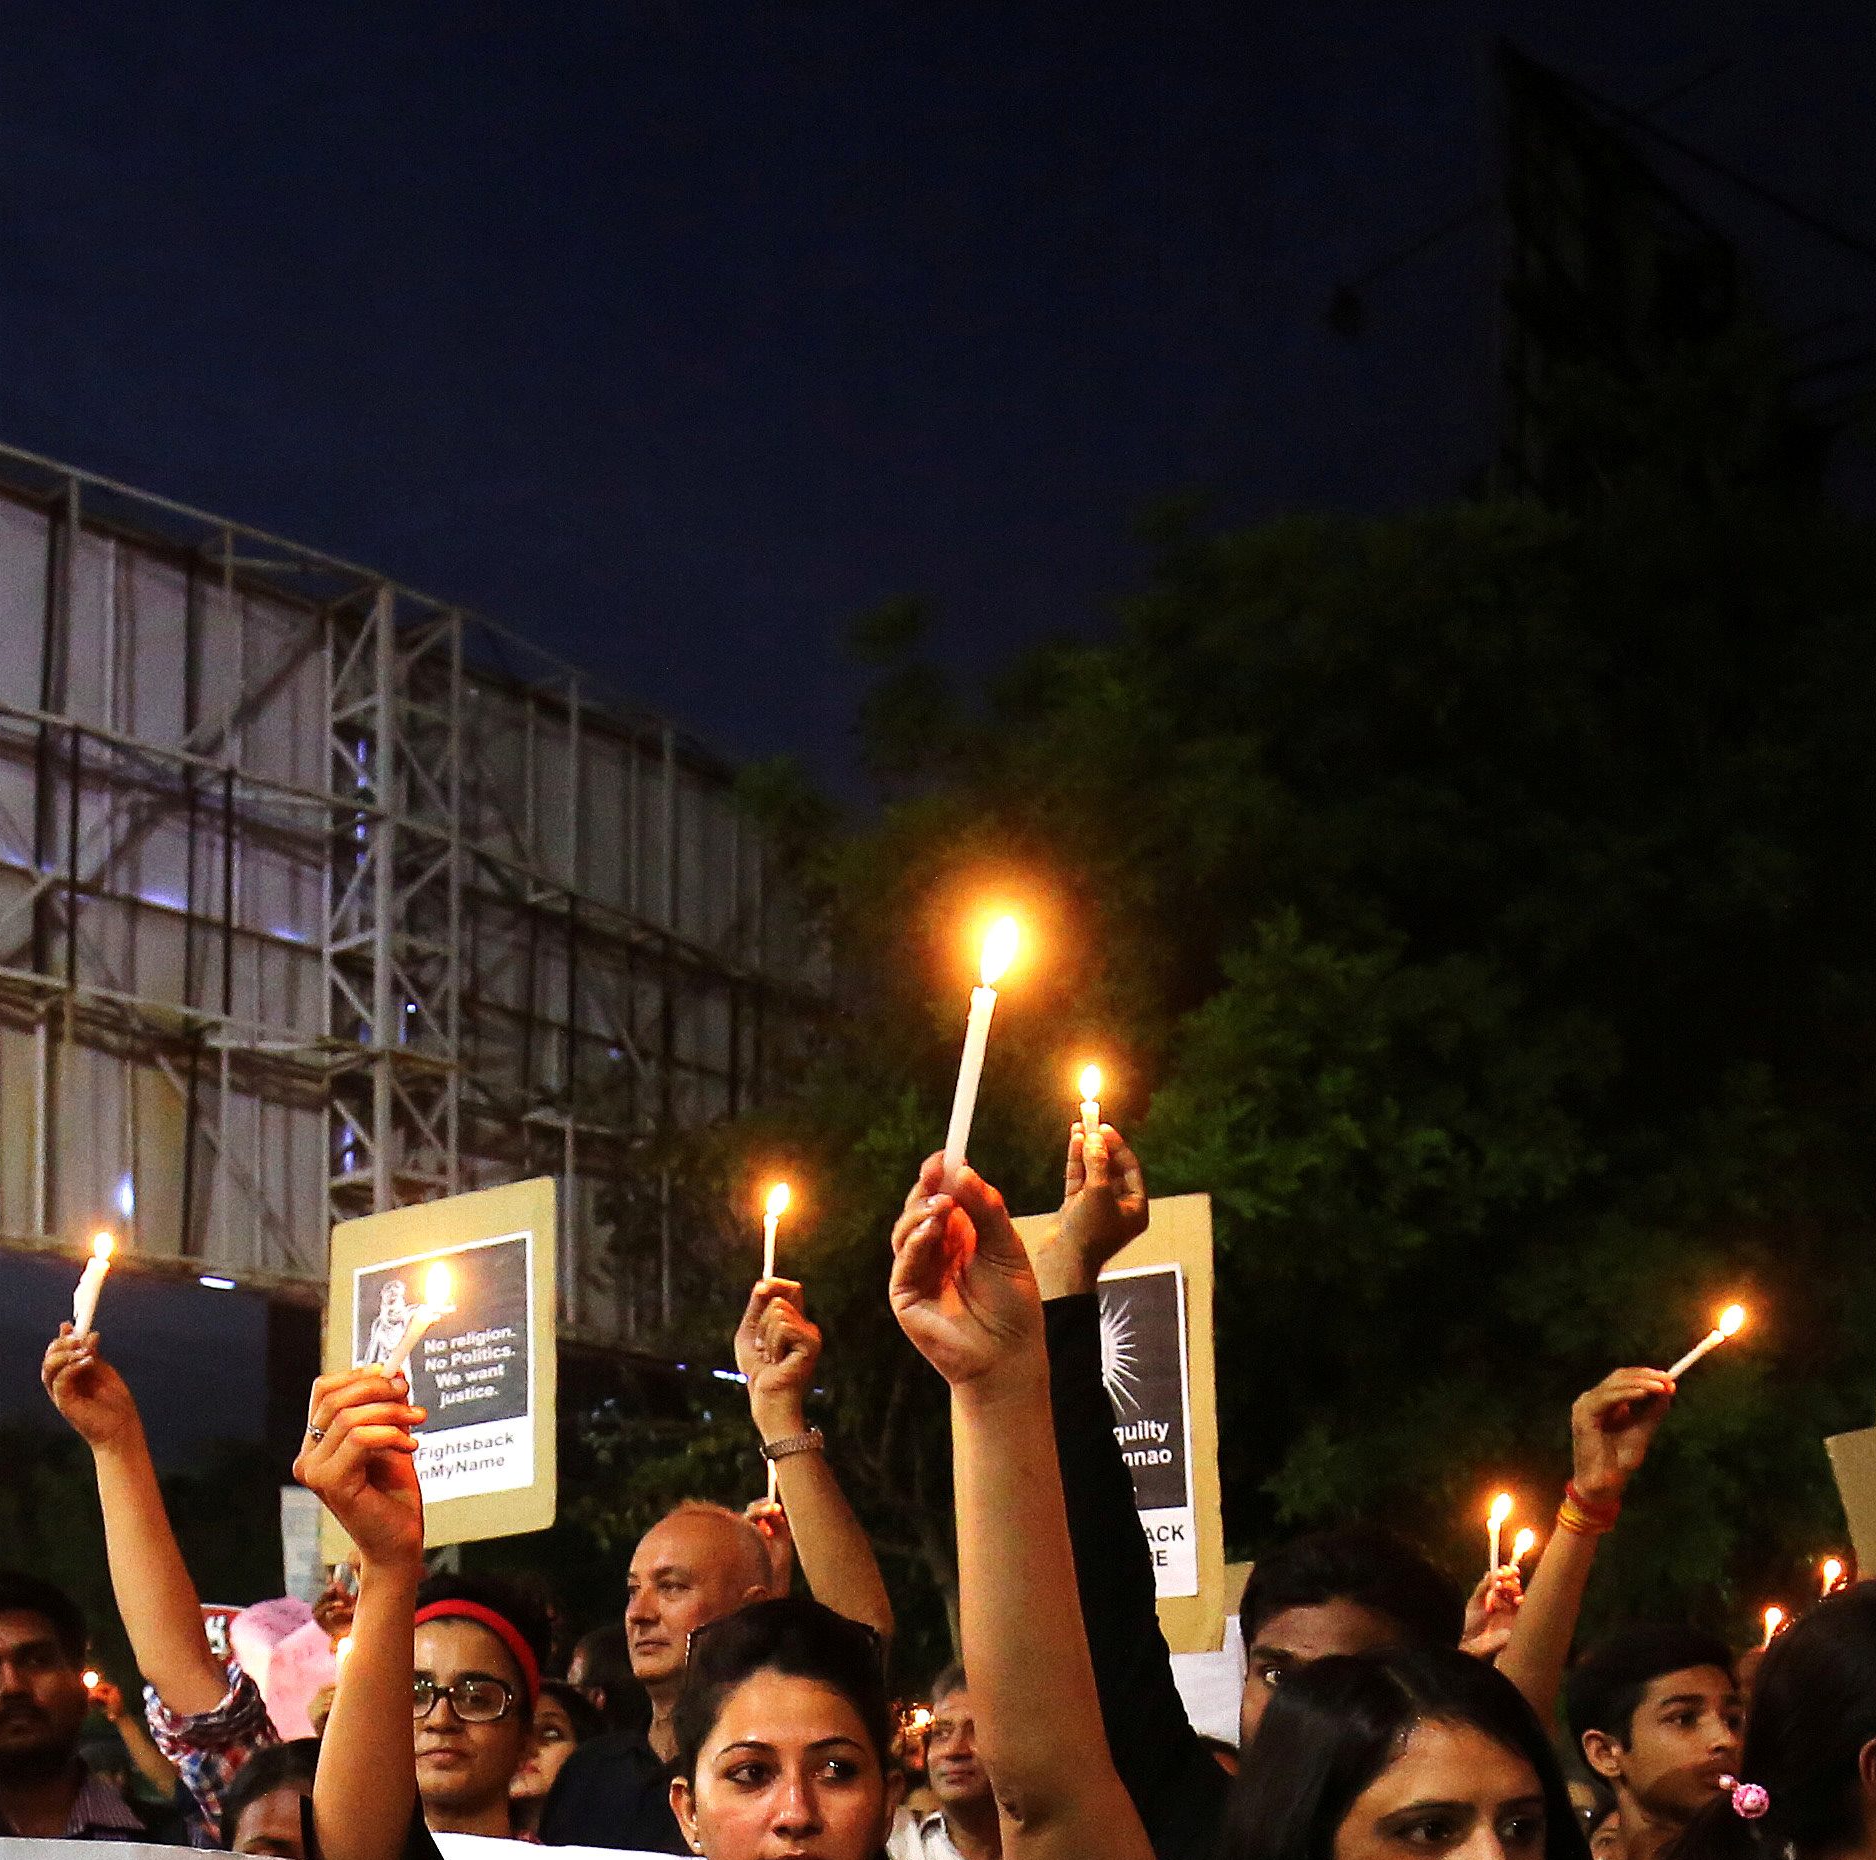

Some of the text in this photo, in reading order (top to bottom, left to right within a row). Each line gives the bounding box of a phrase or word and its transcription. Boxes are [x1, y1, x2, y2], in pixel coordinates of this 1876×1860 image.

[424, 1327, 517, 1354] No religion.
[425, 1345, 515, 1372] No Politics.
[435, 1364, 505, 1389] We want
[439, 1384, 499, 1409] justice.
[413, 1432, 515, 1461] Fightsback
[1122, 1449, 1173, 1467] nnao
[419, 1456, 505, 1480] nMyName
